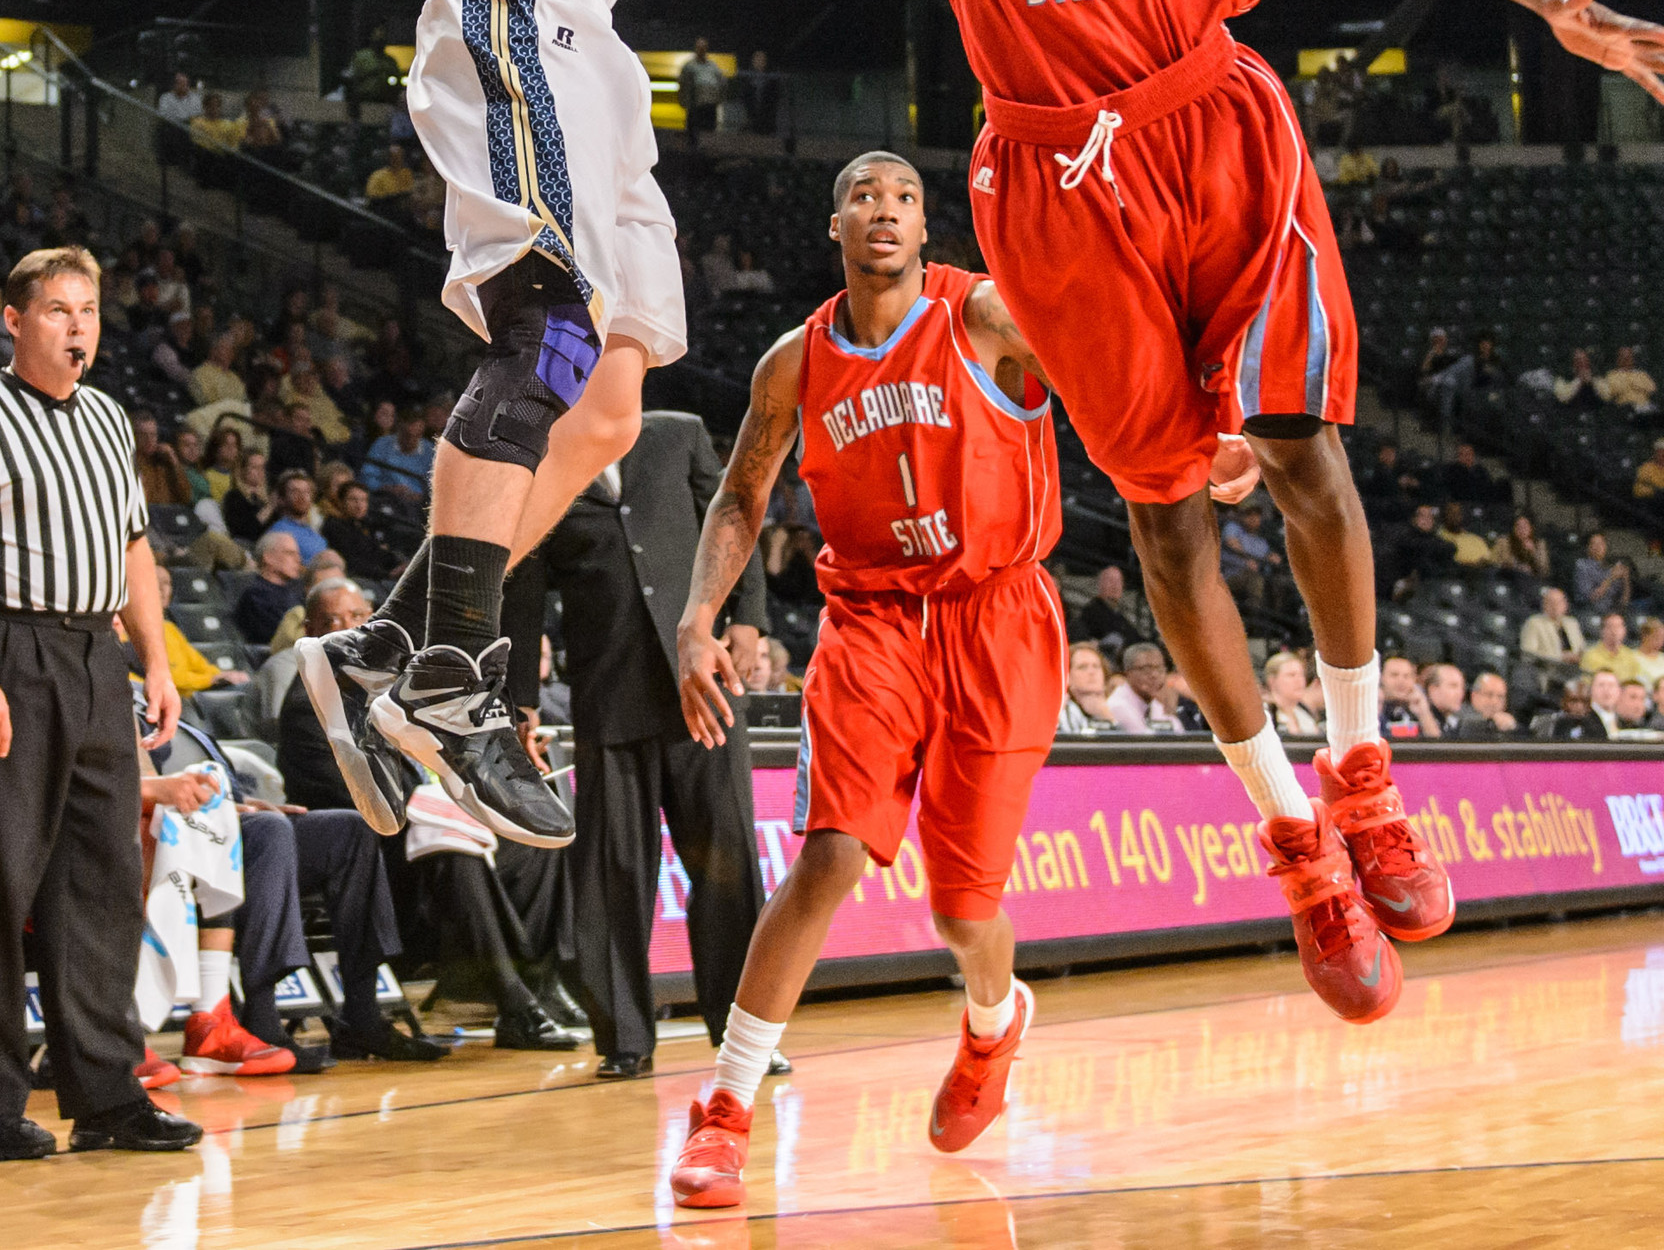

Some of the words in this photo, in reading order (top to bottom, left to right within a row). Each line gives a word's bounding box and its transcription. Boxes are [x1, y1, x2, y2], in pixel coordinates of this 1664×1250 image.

[822, 381, 952, 453] DELAWARE
[898, 451, 917, 508] 1
[890, 508, 958, 558] STATE
[1090, 808, 1173, 886] 140
[1175, 822, 1274, 906] year
[1458, 798, 1494, 862] &
[1492, 792, 1603, 875] stability
